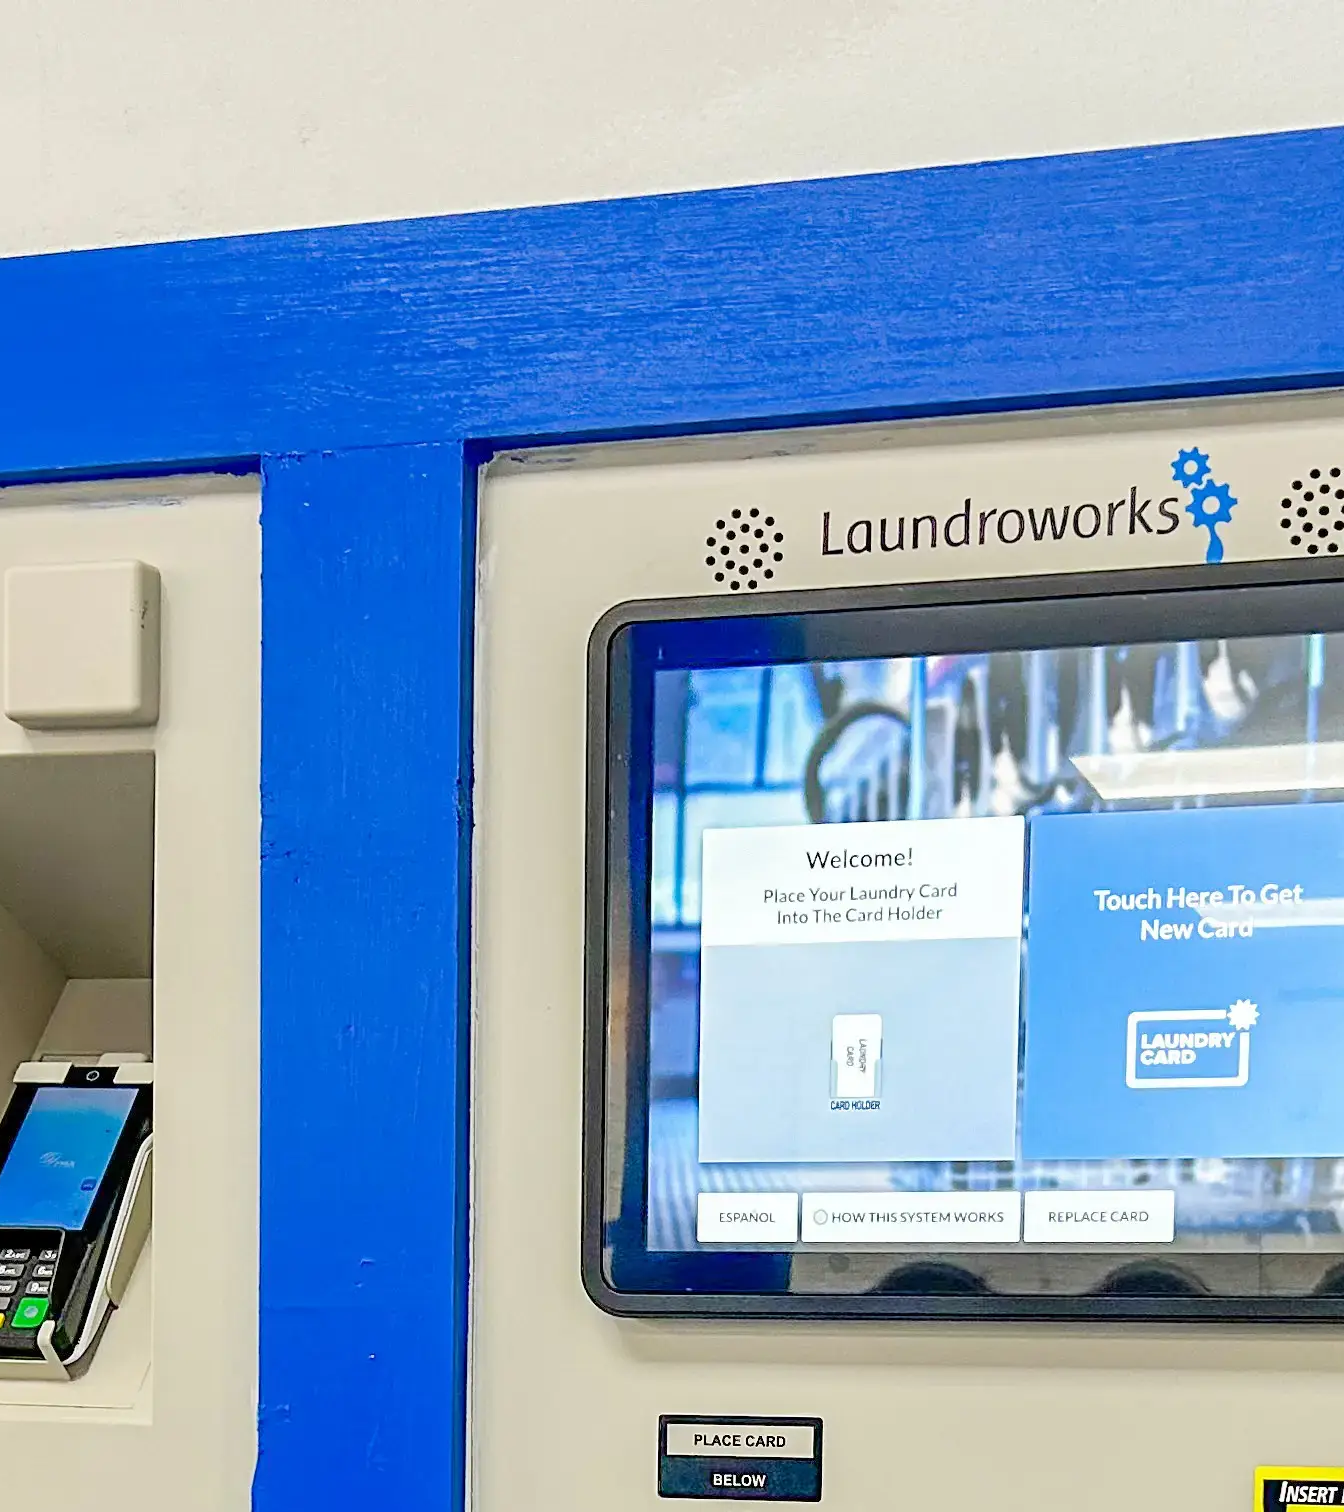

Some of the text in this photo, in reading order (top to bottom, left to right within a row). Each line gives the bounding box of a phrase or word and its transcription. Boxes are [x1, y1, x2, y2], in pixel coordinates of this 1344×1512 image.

[821, 486, 1180, 557] Laundroworks
[806, 848, 913, 869] Welcome!
[764, 883, 957, 903] Place Your Laundry Card
[1093, 883, 1304, 912] Touch Here To Get
[777, 906, 943, 924] Into The Card Holder
[1140, 916, 1254, 941] New Card
[1141, 1032, 1236, 1049] LAUNDRY
[1140, 1049, 1196, 1066] CARD
[830, 1100, 881, 1110] CARD HOLDER
[832, 1212, 1004, 1224] HOW THIS SYSTEM WORKS
[1048, 1211, 1149, 1223] REPLACE CARD
[694, 1434, 786, 1447] PLACE CARD
[713, 1474, 766, 1487] BELOW
[1279, 1481, 1338, 1503] INSERT
